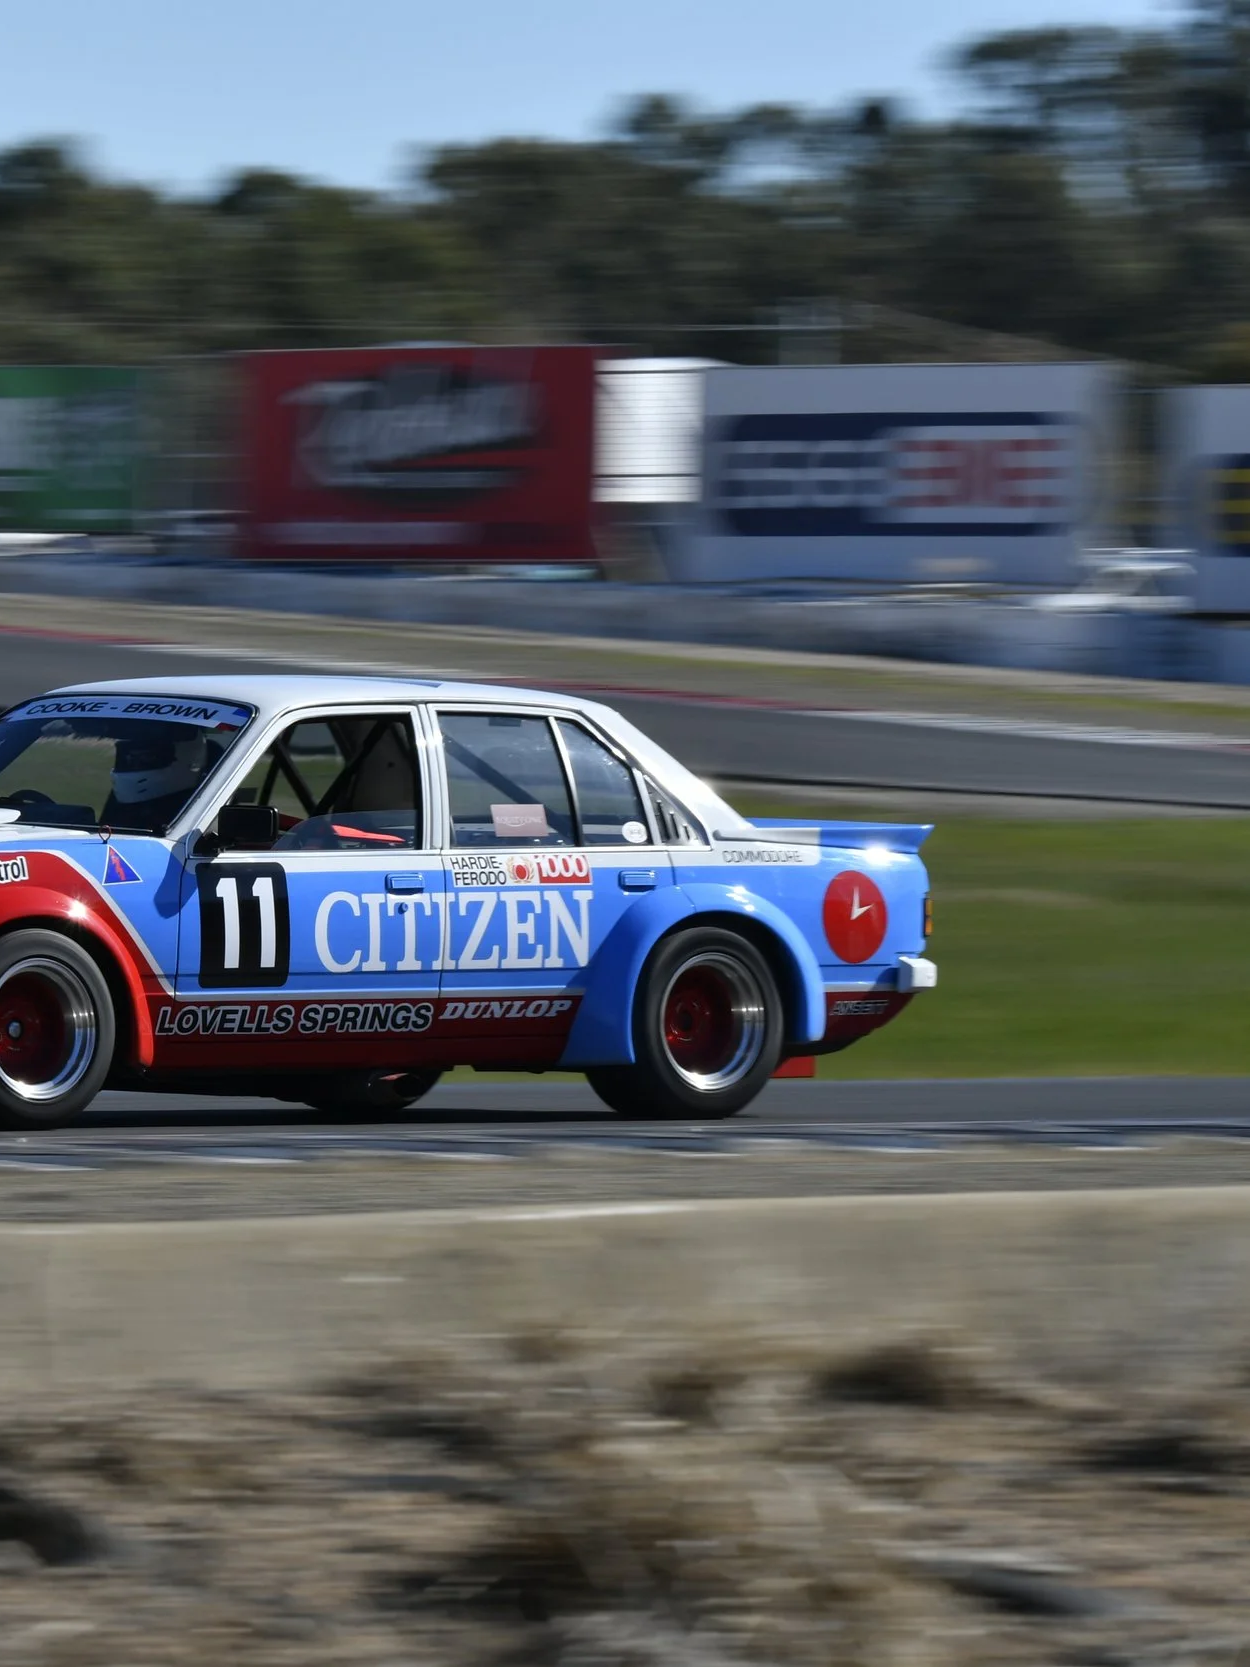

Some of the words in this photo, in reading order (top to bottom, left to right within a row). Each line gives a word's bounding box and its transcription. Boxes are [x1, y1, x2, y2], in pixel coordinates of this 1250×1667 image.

[26, 701, 108, 715] COOKE
[121, 702, 219, 720] BROWN
[450, 855, 502, 870] HARDIE-
[536, 854, 590, 878] 1000
[454, 870, 507, 886] FERODO
[215, 876, 277, 969] 11
[314, 889, 594, 974] CITIZEN
[155, 1003, 294, 1036] LOVELLS
[298, 1001, 434, 1034] SPRINGS
[438, 1000, 572, 1020] DUNLOP
